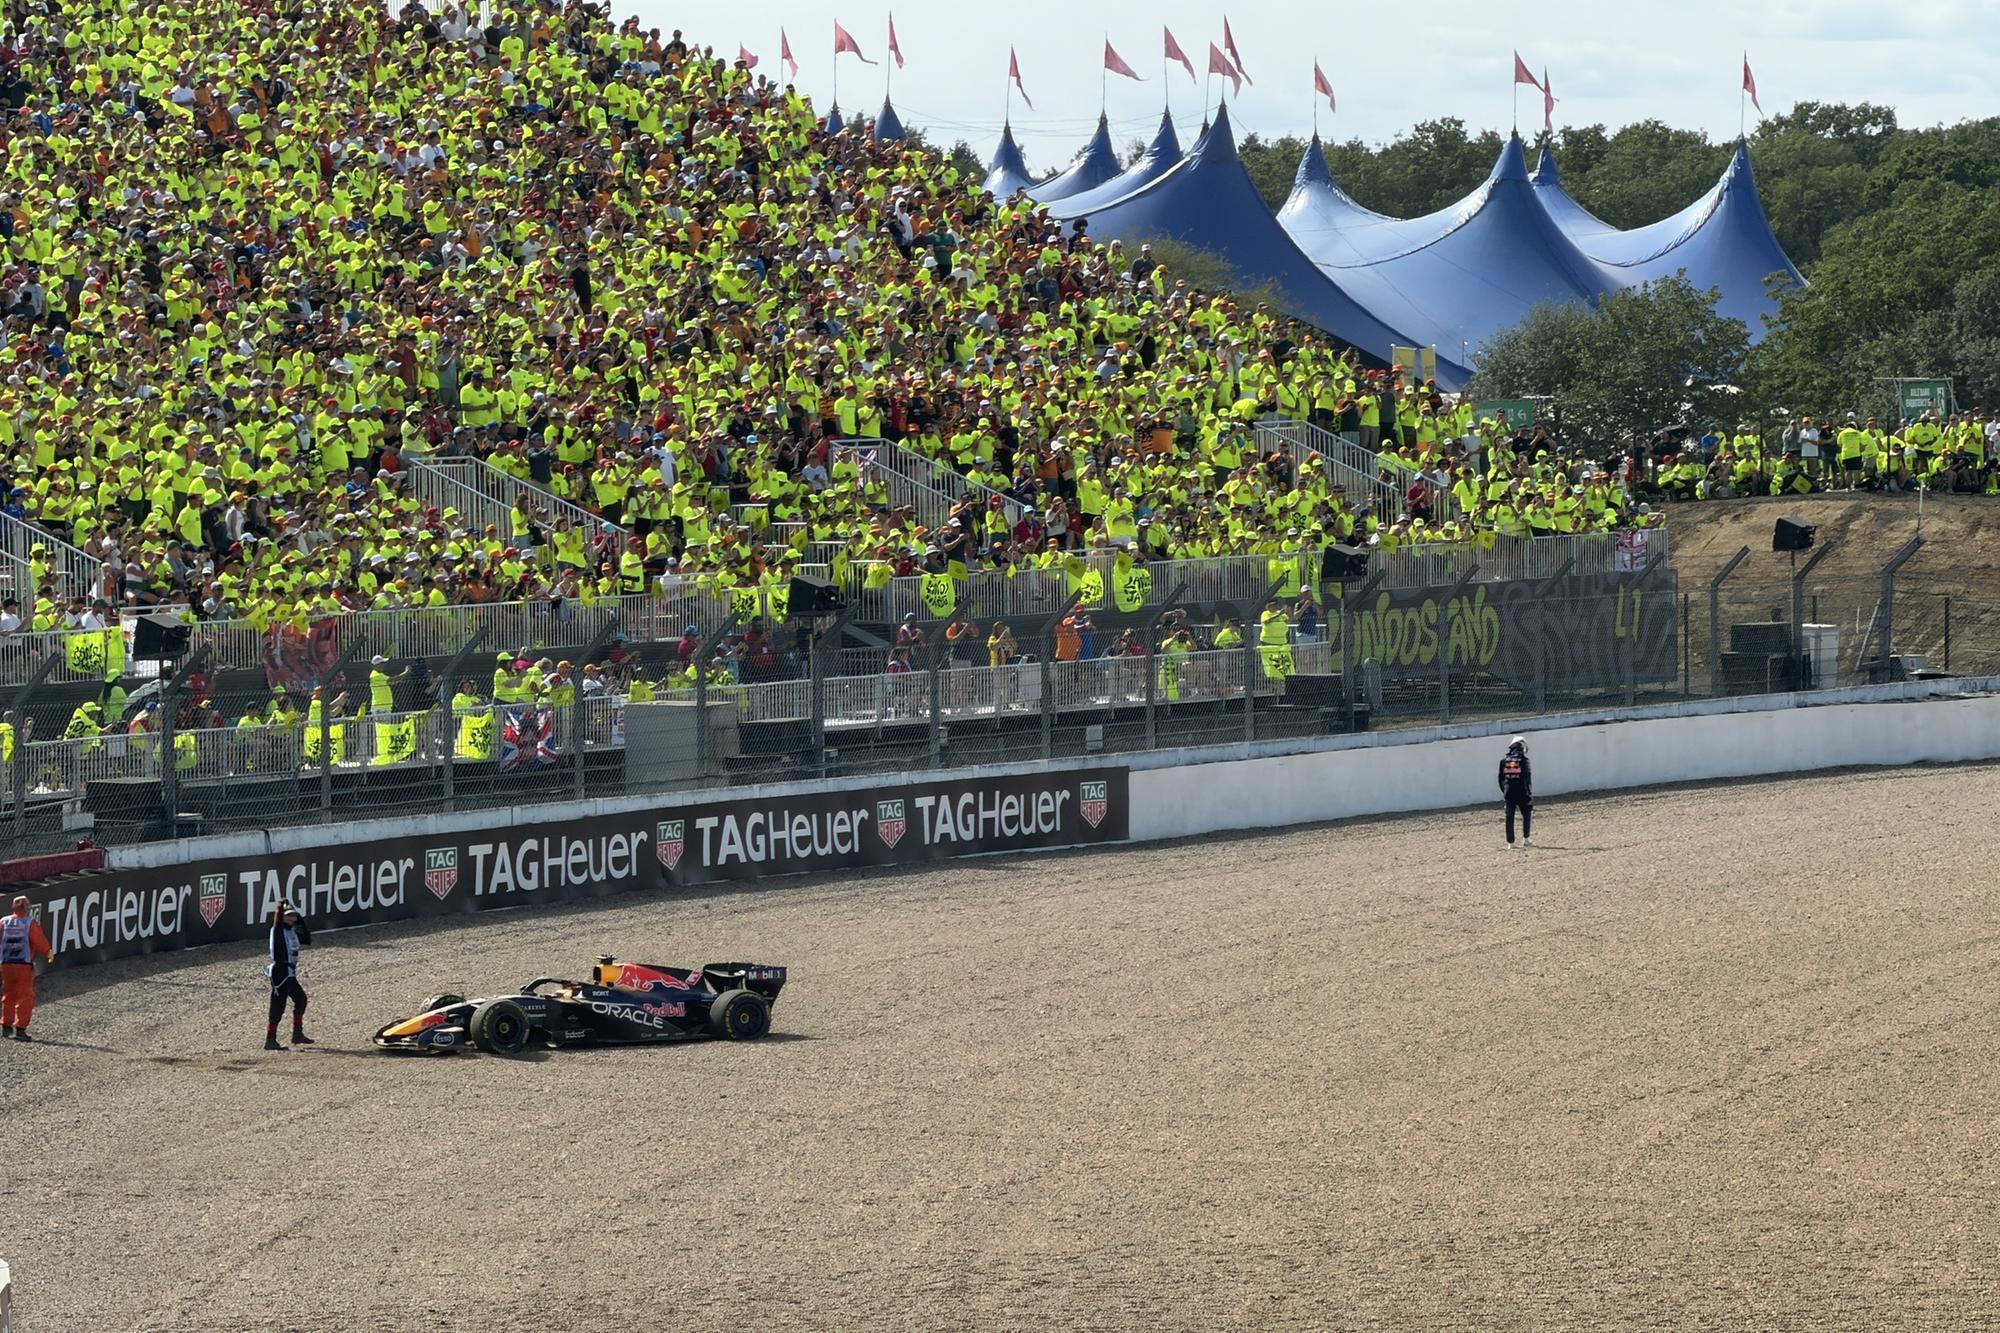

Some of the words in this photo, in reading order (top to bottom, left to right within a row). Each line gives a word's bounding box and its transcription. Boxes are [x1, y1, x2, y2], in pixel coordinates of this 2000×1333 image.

[1082, 783, 1105, 800] TAG
[879, 803, 903, 819] TAG
[1081, 801, 1107, 825] HEUER
[658, 823, 682, 840] TAG
[879, 820, 904, 844] HEUER
[428, 850, 455, 868] TAG
[657, 840, 683, 866] HEUER
[202, 875, 224, 894] TAG
[426, 869, 456, 896] HEUER
[201, 897, 224, 921] HEUER
[748, 970, 773, 980] Mobil
[591, 1002, 663, 1029] ORACLE
